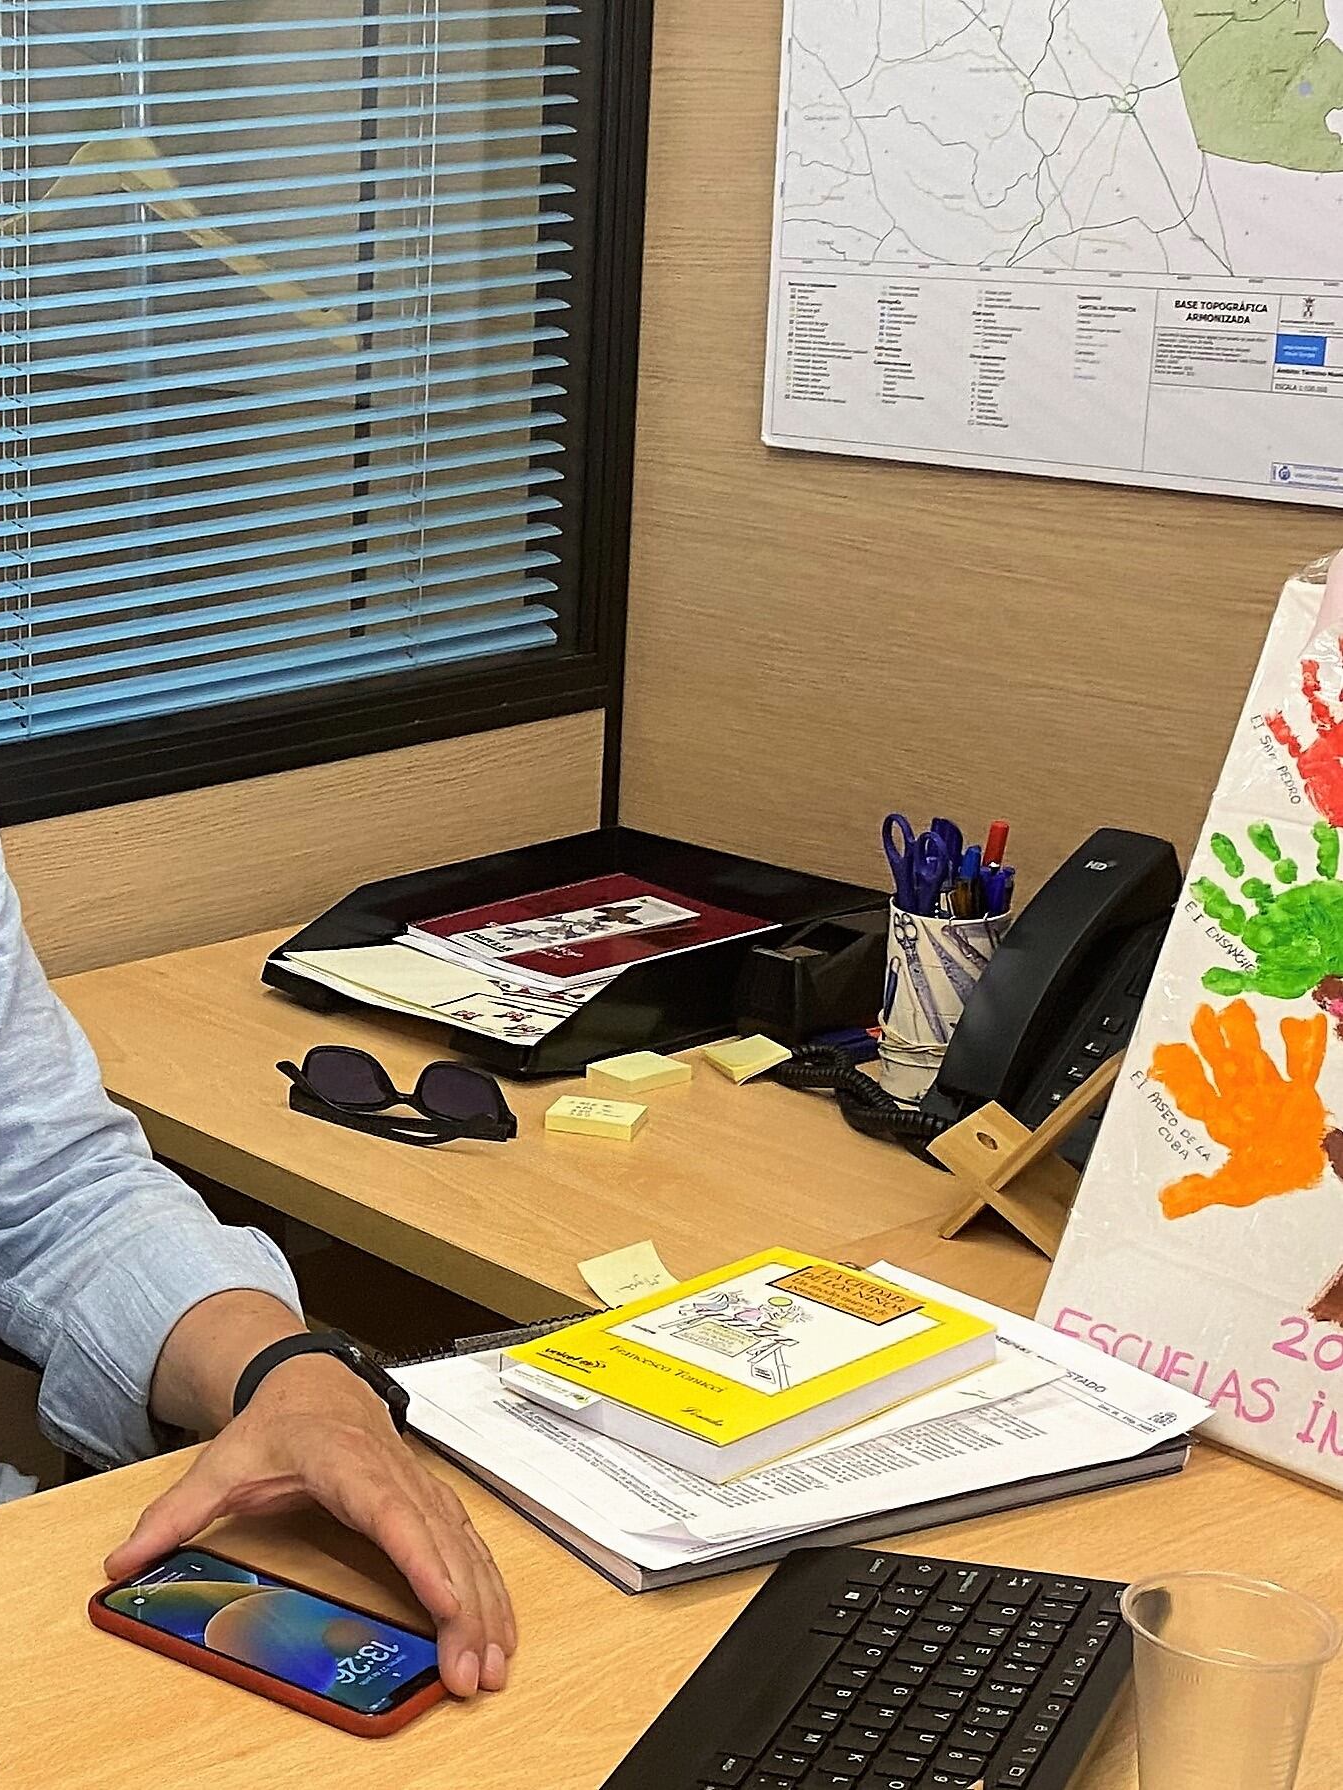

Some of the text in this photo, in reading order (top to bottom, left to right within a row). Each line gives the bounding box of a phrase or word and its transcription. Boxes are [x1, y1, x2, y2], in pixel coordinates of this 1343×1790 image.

[1174, 300, 1268, 313] BASE TOPOGRÁFICA
[1185, 313, 1251, 324] ARMONIZADA
[1276, 765, 1301, 805] PEDRO
[1147, 1091, 1179, 1128] PASEO
[1180, 1128, 1195, 1146] DE
[1195, 1144, 1212, 1162] LA
[1158, 1127, 1189, 1161] CUBA
[800, 1272, 821, 1283] DE
[823, 1279, 852, 1293] LOS
[844, 1278, 906, 1304] CIUDAD
[609, 1344, 671, 1373] Francesco
[673, 1367, 728, 1394] Tonucci
[894, 1608, 910, 1616] Z
[1000, 1607, 1017, 1615] Q
[881, 1627, 897, 1637] X
[936, 1624, 952, 1632] S
[988, 1627, 1005, 1637] W
[866, 1648, 882, 1656] C
[922, 1644, 939, 1653] D
[975, 1647, 992, 1655] E
[335, 1640, 400, 1684] 13:26
[909, 1665, 924, 1673] F
[961, 1668, 978, 1677] R
[852, 1670, 868, 1678] V
[836, 1689, 852, 1697] B
[893, 1687, 909, 1695] G
[948, 1690, 964, 1698] T
[821, 1711, 838, 1720] N
[879, 1708, 895, 1718] H
[803, 1733, 822, 1743] M
[919, 1734, 936, 1743] U
[847, 1753, 865, 1763] K
[948, 1751, 964, 1759] 8
[933, 1775, 948, 1783] 9
[888, 1780, 905, 1790] O
